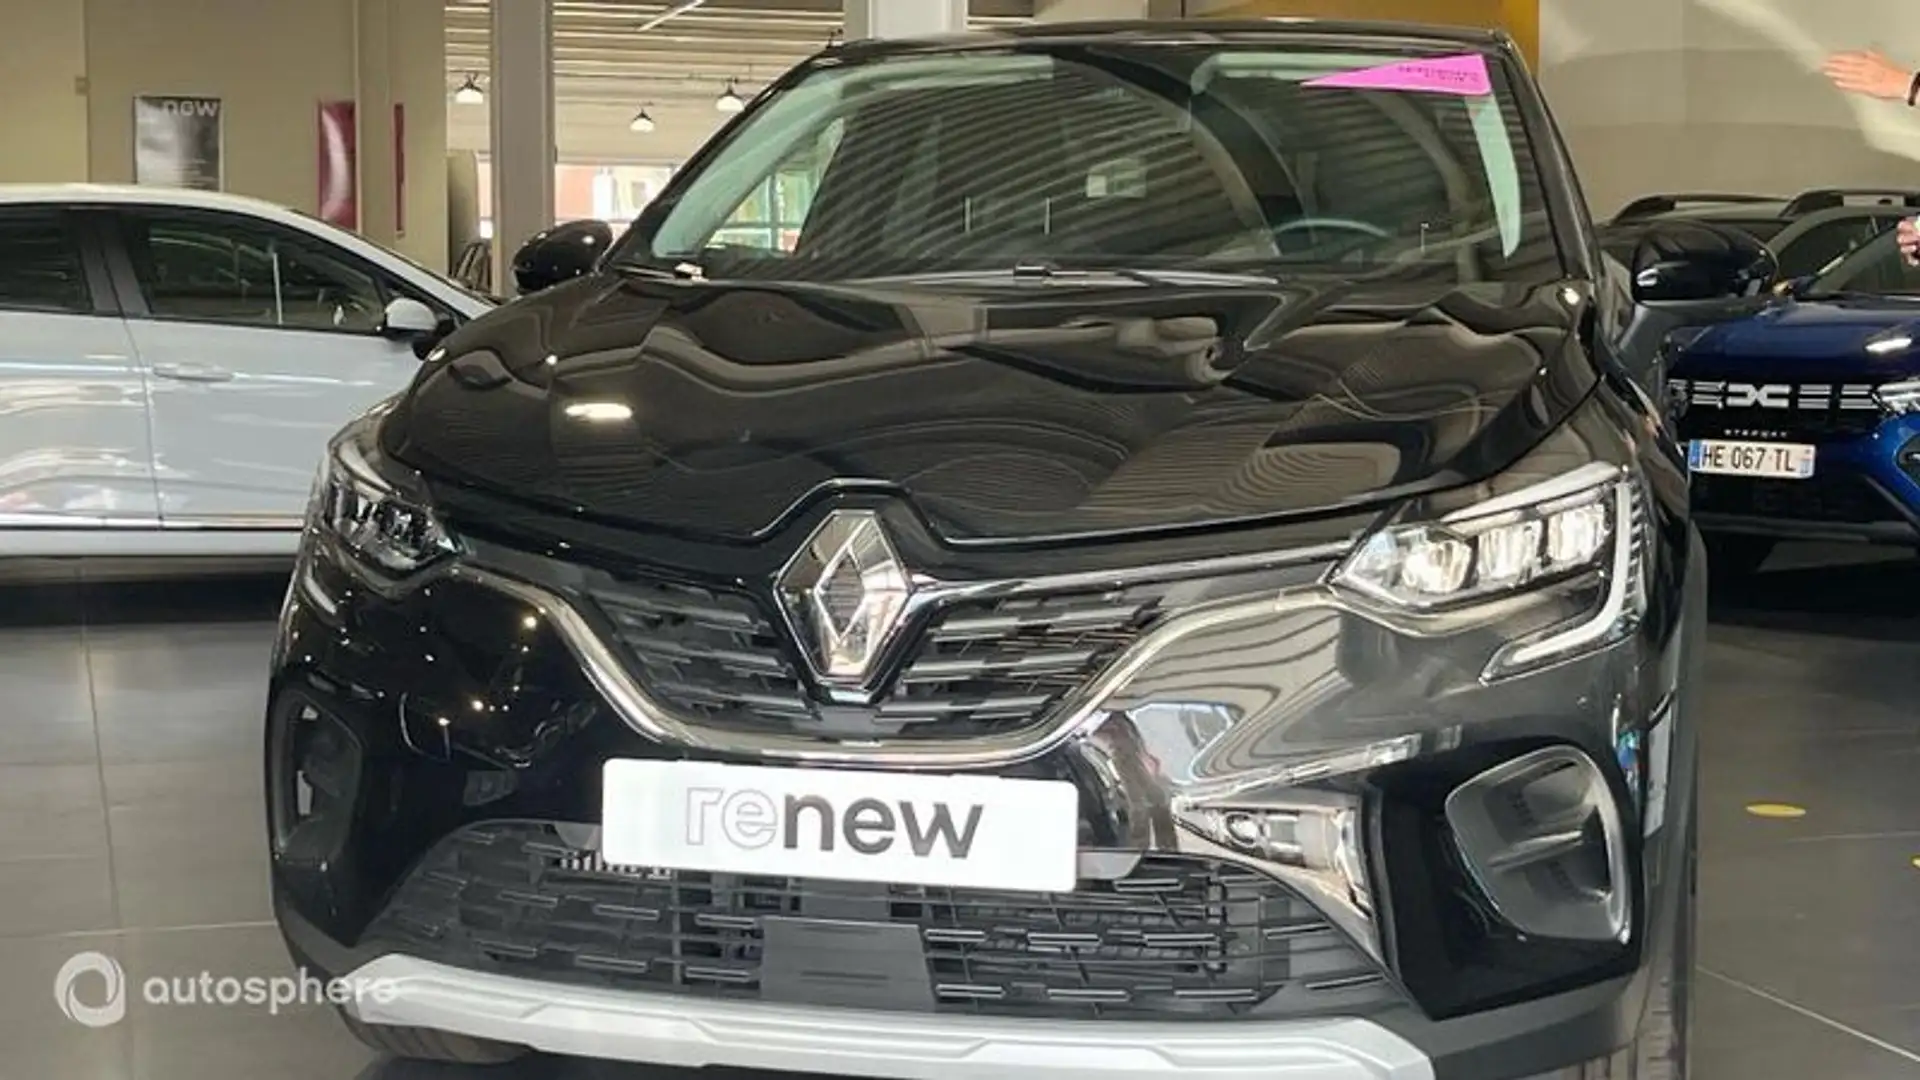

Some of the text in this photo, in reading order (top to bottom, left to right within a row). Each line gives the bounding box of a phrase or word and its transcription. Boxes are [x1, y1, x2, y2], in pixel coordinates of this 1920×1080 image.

[1701, 444, 1725, 468] HE
[1731, 446, 1767, 471] 067
[1773, 448, 1796, 472] TL
[686, 787, 984, 859] renew
